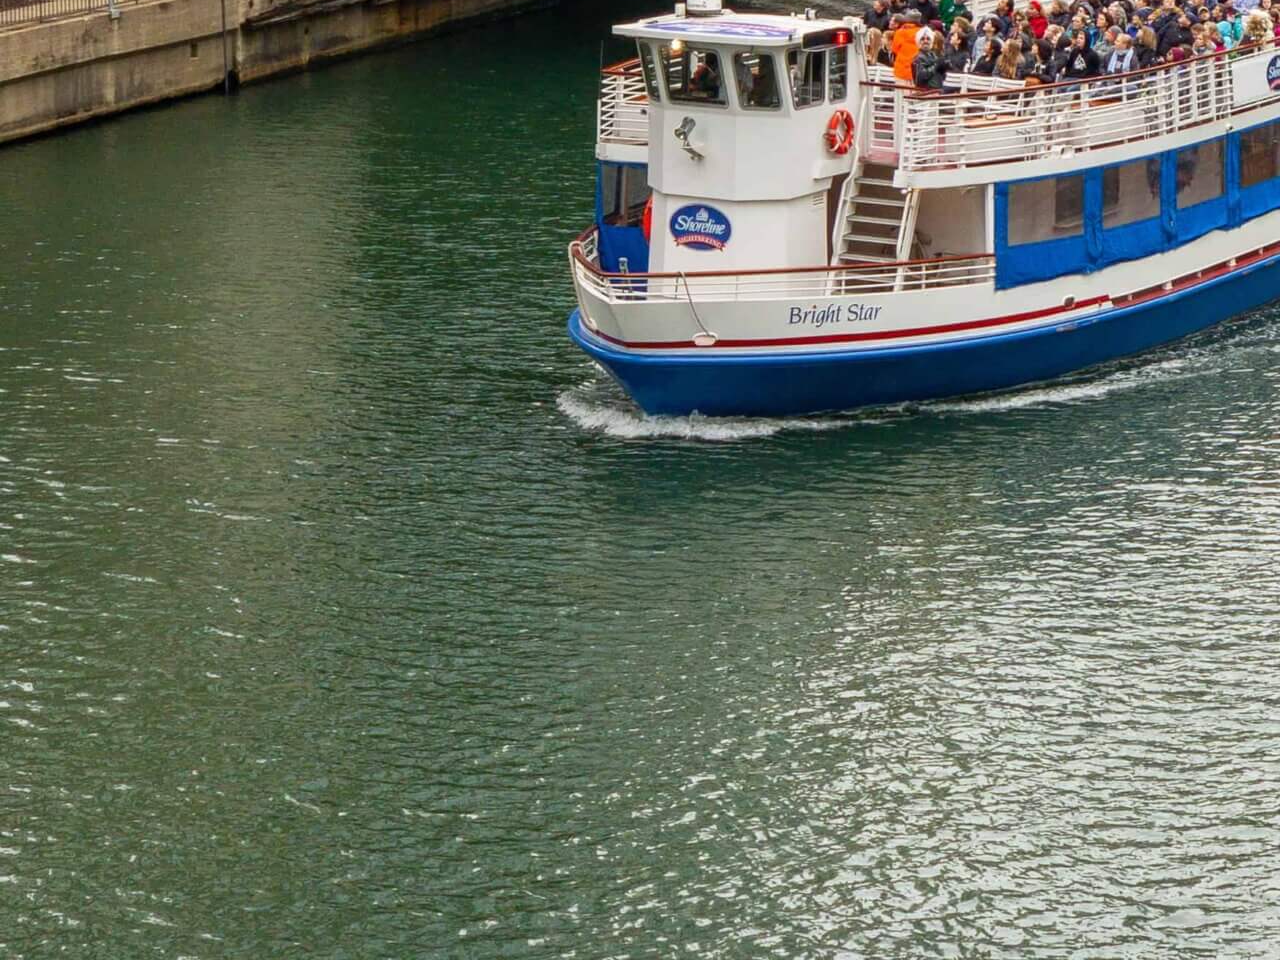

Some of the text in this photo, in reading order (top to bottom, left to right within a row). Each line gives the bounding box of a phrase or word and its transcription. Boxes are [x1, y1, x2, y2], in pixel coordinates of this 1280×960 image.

[674, 215, 726, 236] Shoreline
[789, 303, 882, 328] Bright Star
